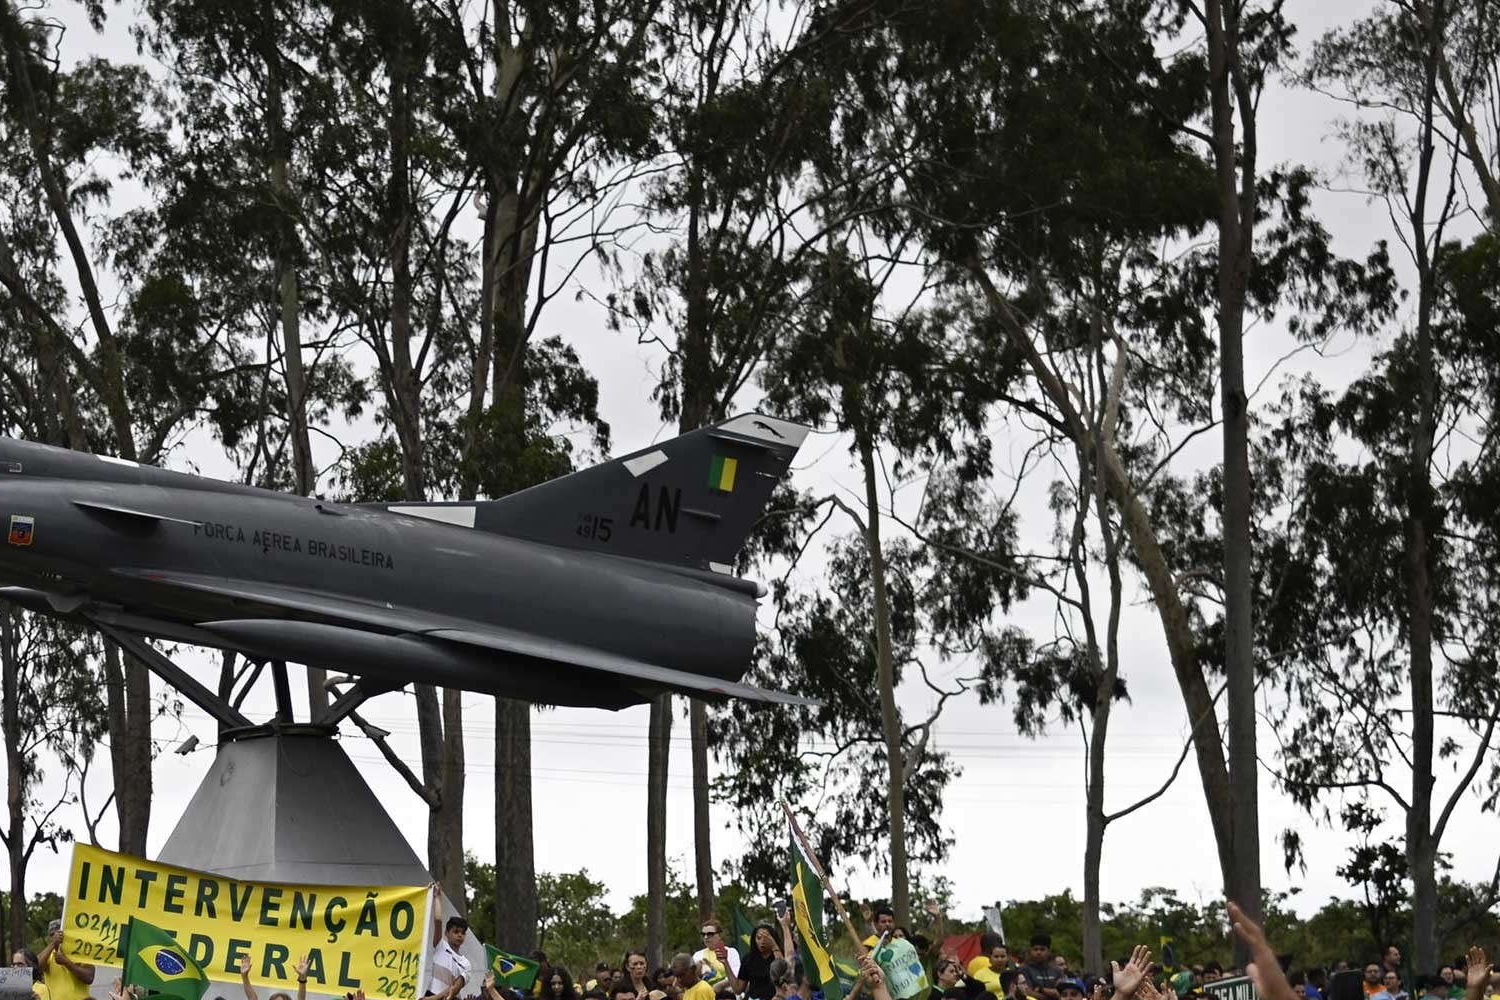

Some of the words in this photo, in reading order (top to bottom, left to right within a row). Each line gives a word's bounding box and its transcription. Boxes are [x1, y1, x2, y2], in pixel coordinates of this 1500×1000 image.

[630, 482, 682, 535] AN
[308, 540, 394, 570] BRASILEIRA
[78, 861, 415, 943] INTERVENÇÃO
[71, 938, 116, 965] 2022
[116, 922, 362, 989] DERAL
[376, 976, 417, 1000] 2022
